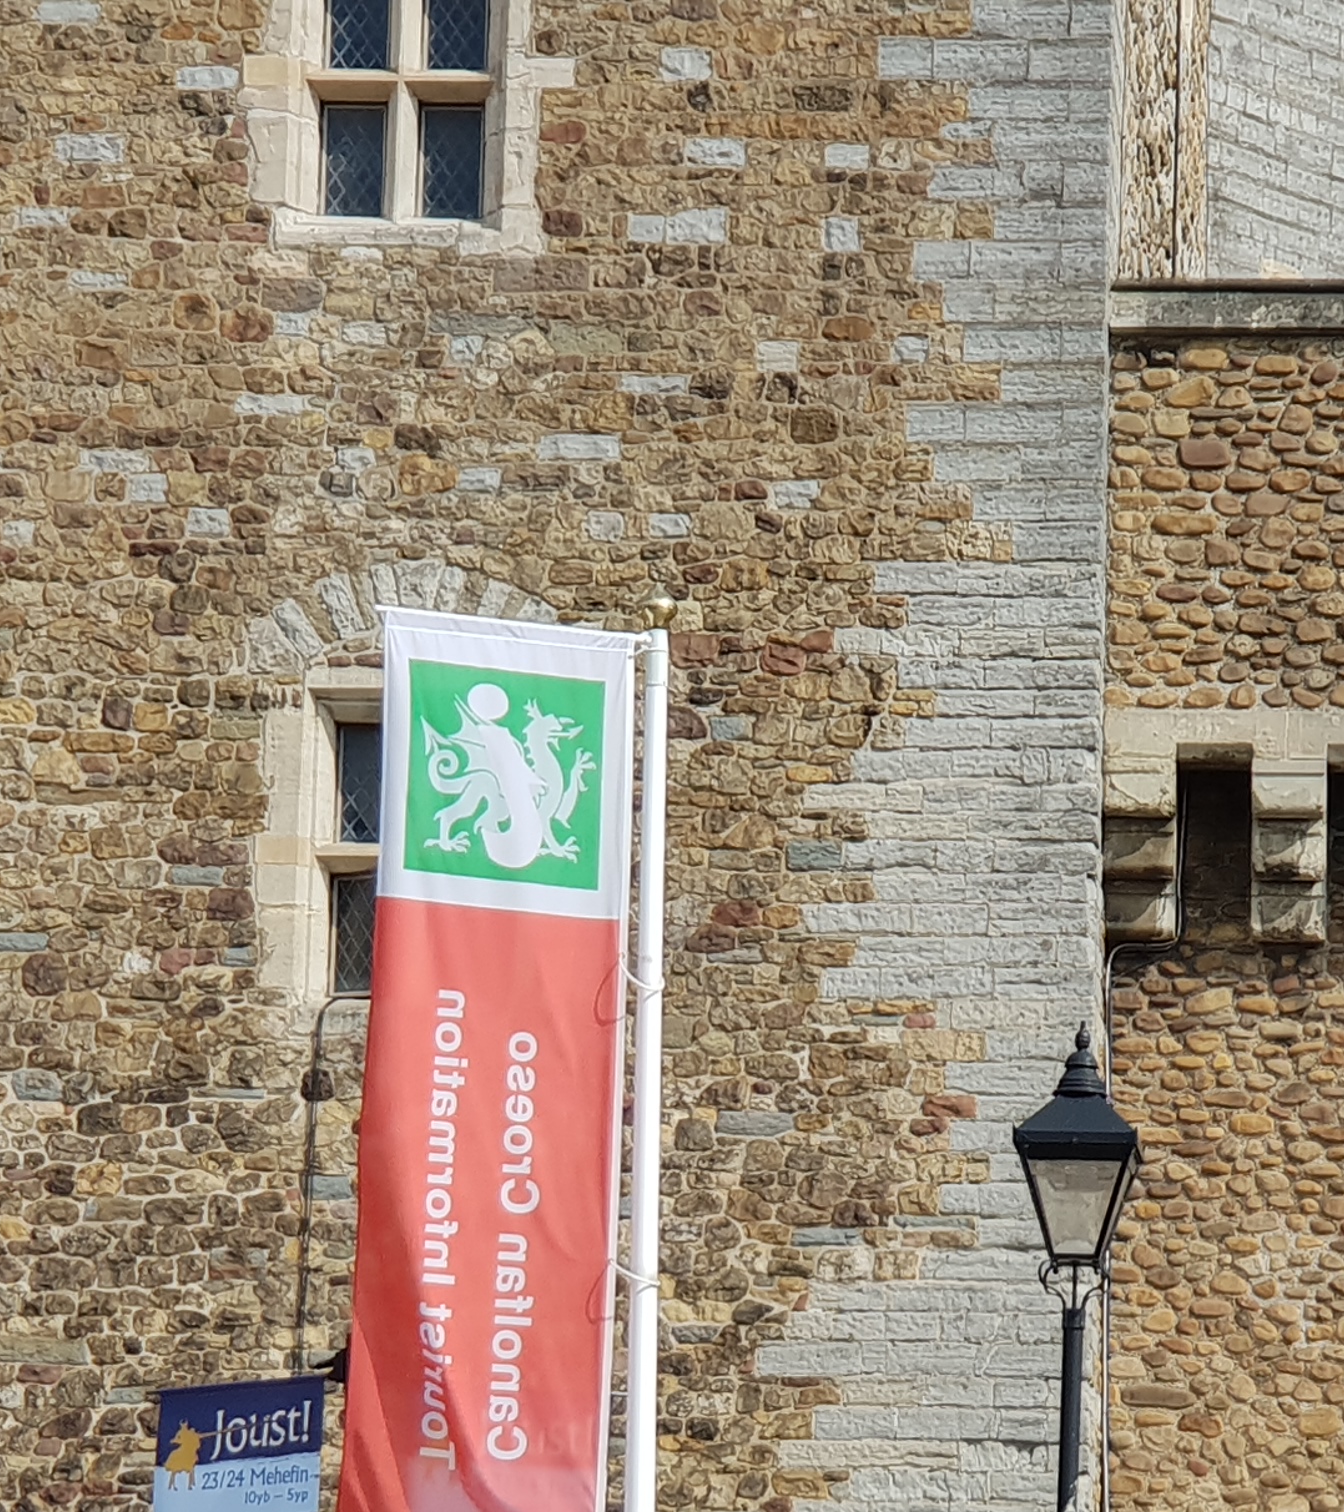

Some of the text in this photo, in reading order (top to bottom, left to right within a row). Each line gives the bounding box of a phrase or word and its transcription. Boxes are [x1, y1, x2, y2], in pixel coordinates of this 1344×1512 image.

[210, 1400, 312, 1460] Joust!
[201, 1465, 309, 1490] 23/24 Mehefin
[245, 1490, 270, 1505] 10yb
[287, 1489, 309, 1503] 5yp
